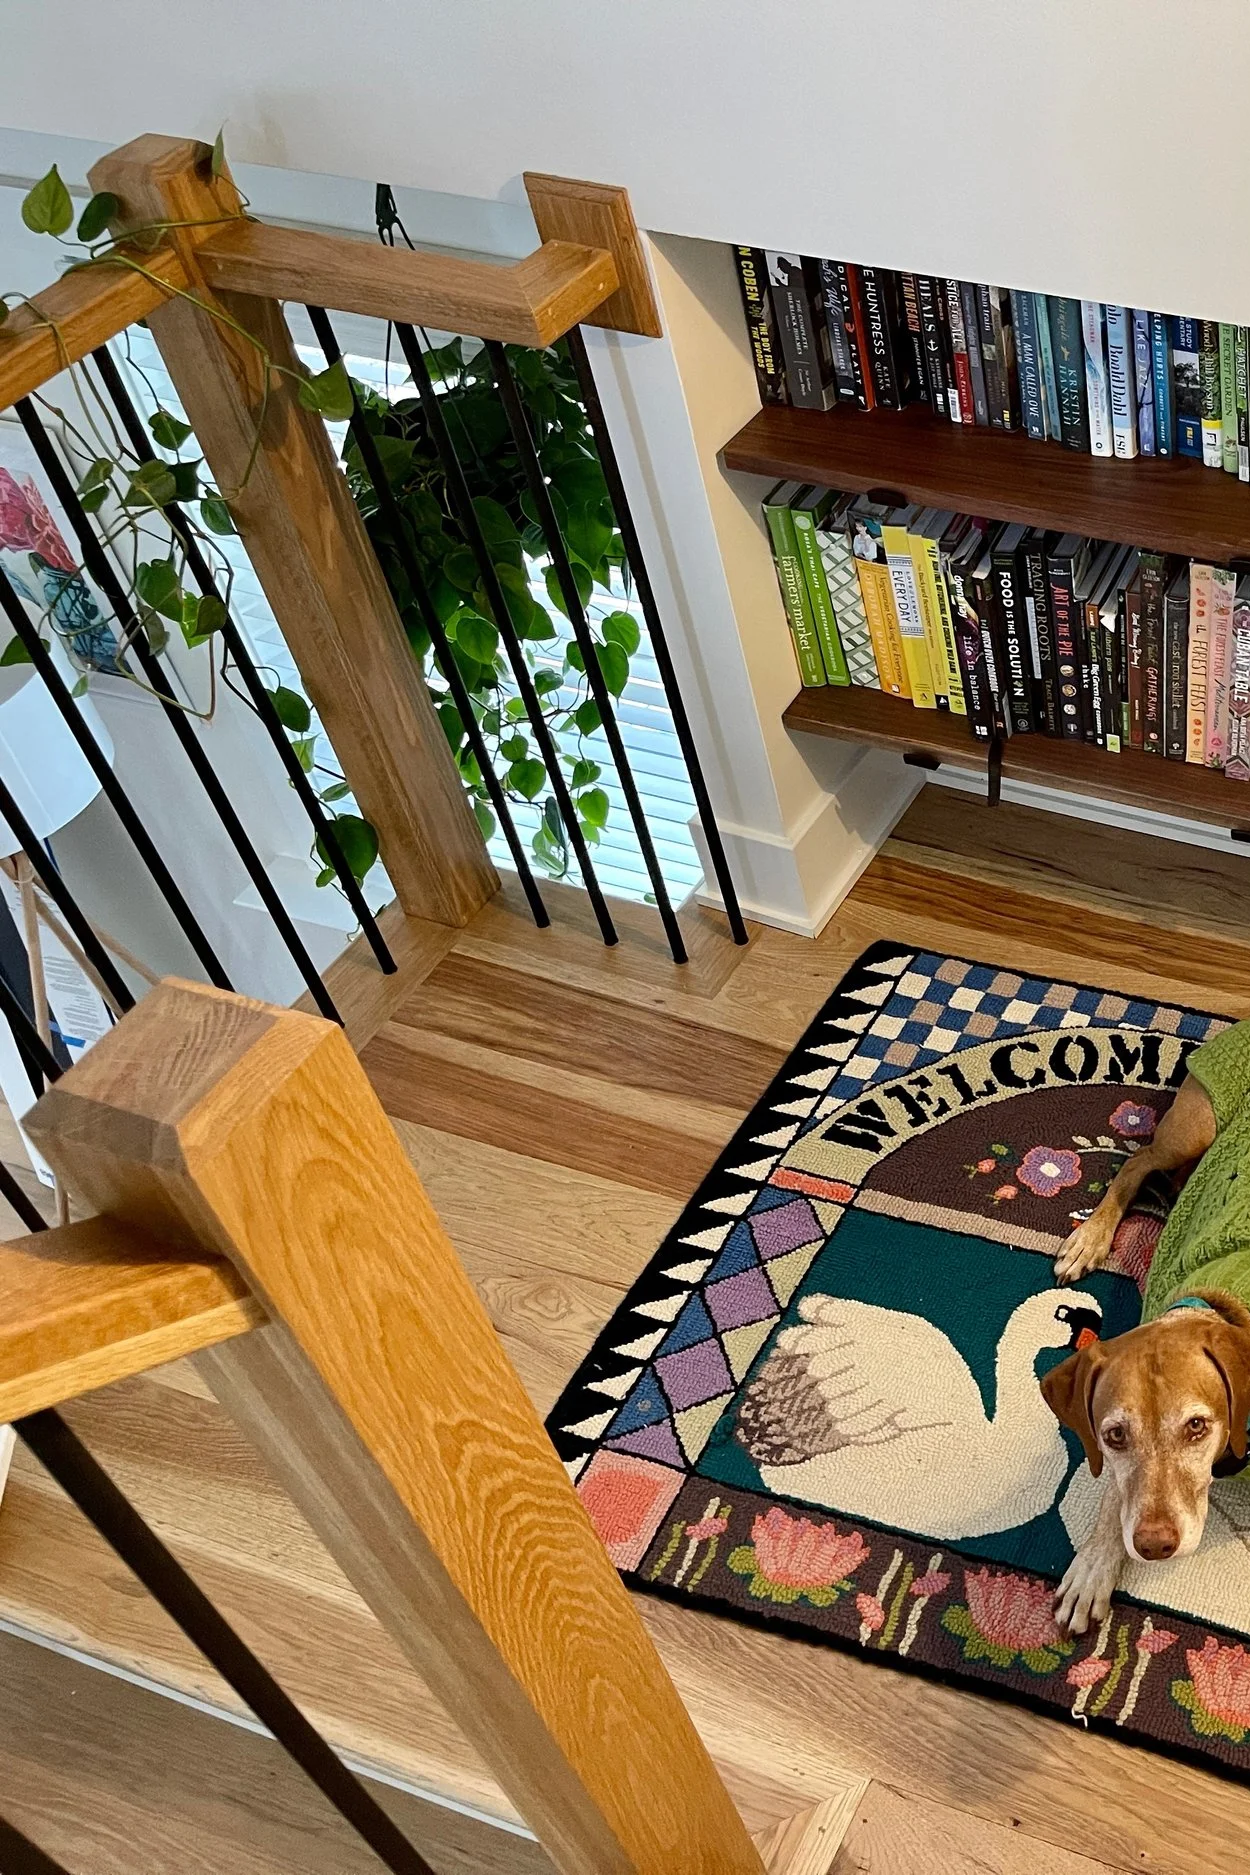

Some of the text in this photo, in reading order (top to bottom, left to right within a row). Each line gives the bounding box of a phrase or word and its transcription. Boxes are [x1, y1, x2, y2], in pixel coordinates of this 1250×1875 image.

[741, 261, 759, 301] COBEN
[837, 265, 861, 384] DICAL PLATT
[863, 269, 885, 355] E HUNTRESS
[1185, 324, 1193, 348] STUDY
[759, 322, 775, 374] THE BOY FROM
[1023, 342, 1034, 364] MAN
[1110, 344, 1125, 382] Roald
[1136, 319, 1147, 388] LIKE JAZZ
[1237, 347, 1246, 398] HATCHET
[1025, 366, 1037, 397] CALLED
[1059, 365, 1071, 426] HANNAH
[1068, 369, 1080, 426] KRISTIN
[1112, 384, 1127, 417] Dahl
[1029, 399, 1039, 417] OVE
[781, 555, 813, 651] farmers' market
[892, 570, 911, 623] EVERY DAY
[954, 574, 969, 619] donna hay
[999, 571, 1013, 607] FOOD
[1007, 620, 1015, 635] THE
[1030, 552, 1050, 660] TRACING ROOTS
[1050, 582, 1074, 656] ART OF THE PIE
[863, 573, 892, 680] DEBORAH MADISON
[1216, 633, 1227, 656] FOREST
[1217, 617, 1228, 632] THE
[963, 635, 982, 710] life in balance
[1082, 664, 1090, 689] shake
[1192, 640, 1207, 716] FOREST FEAST
[1214, 656, 1226, 677] FEAST
[1235, 628, 1250, 702] CUBAN TABLE
